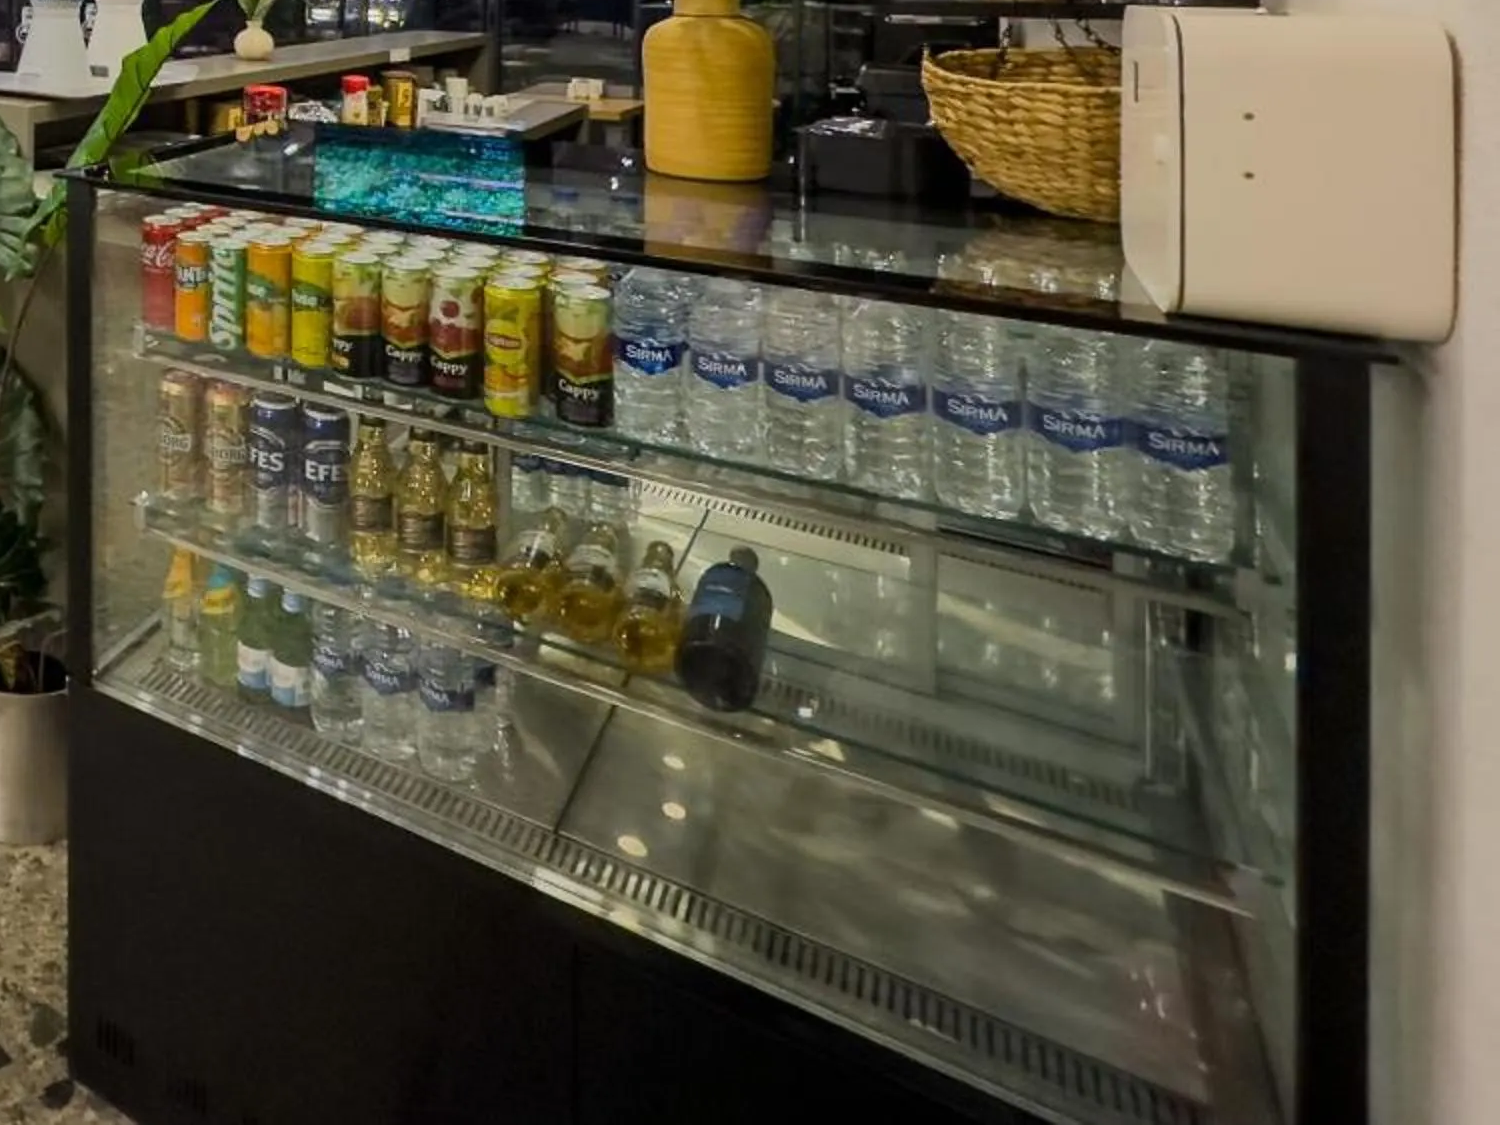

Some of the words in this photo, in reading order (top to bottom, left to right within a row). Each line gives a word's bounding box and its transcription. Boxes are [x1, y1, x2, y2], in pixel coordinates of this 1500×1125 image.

[385, 343, 422, 363] Cappy
[626, 344, 673, 363] SIRMA
[430, 355, 469, 375] Cappy
[698, 356, 748, 376] SIRMA
[558, 377, 600, 401] Cappy
[774, 370, 828, 390] SIRMA
[853, 384, 910, 406] SIRMA
[947, 398, 1009, 422] SIRMA
[1043, 414, 1107, 440] SIRMA
[1149, 432, 1220, 456] SIRMA
[305, 459, 343, 482] EFE
